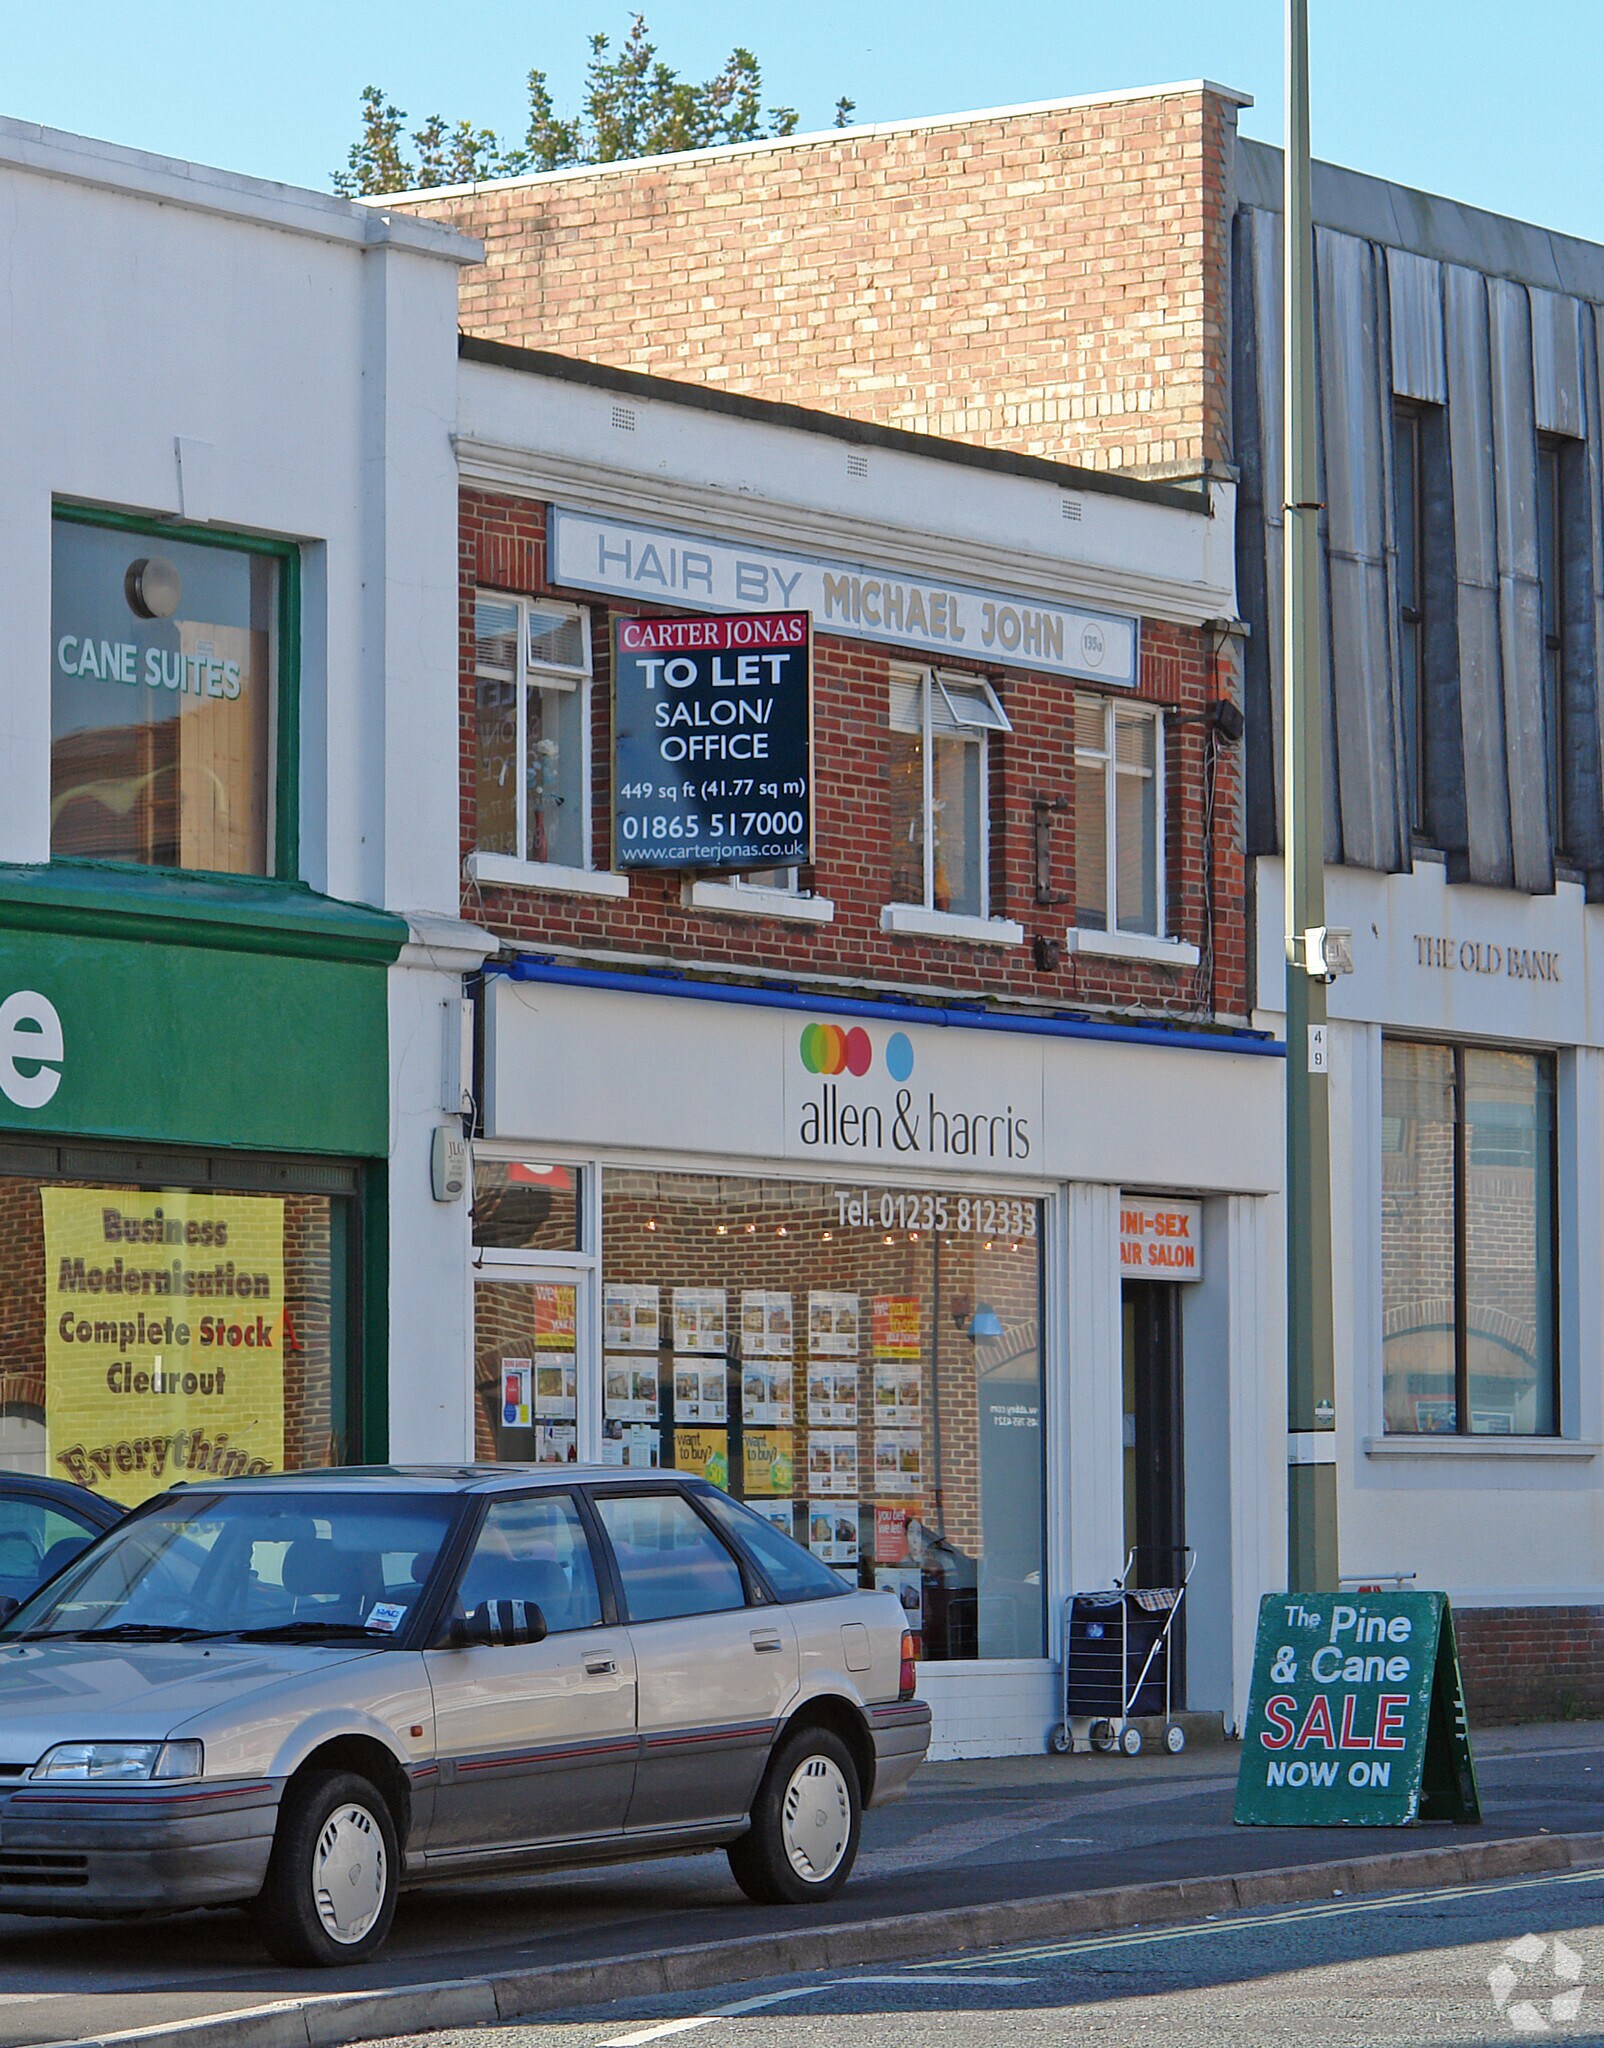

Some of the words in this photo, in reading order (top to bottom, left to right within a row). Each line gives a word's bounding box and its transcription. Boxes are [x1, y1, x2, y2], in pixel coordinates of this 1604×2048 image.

[598, 533, 713, 594] HAIR
[736, 560, 803, 608] BY
[823, 571, 966, 642] MICHAEL
[982, 604, 1064, 660] JOHN
[624, 622, 719, 648] CARTER
[725, 619, 802, 649] JONAS
[58, 634, 138, 684] CANE
[144, 647, 241, 700] SUITES
[636, 657, 698, 688] TO
[712, 654, 790, 686] LET
[655, 698, 773, 727] SALON/
[660, 733, 769, 762] OFFICE
[621, 782, 652, 799] 449
[658, 787, 677, 802] sq
[682, 781, 696, 798] ft
[701, 779, 754, 801] (41.77
[759, 783, 778, 799] sq
[783, 777, 806, 798] m)
[622, 815, 699, 839] 01865
[709, 811, 803, 837] 517000
[622, 840, 804, 862] www.carterjonas.co.uk
[1414, 934, 1457, 969] THE
[1460, 940, 1502, 974] OLD
[1507, 947, 1560, 982] BANK
[0, 990, 64, 1109] e
[1314, 1031, 1322, 1044] 4
[1314, 1052, 1322, 1065] 9
[801, 1083, 882, 1148] allen
[892, 1089, 920, 1151] &
[929, 1093, 1030, 1159] harris
[102, 1206, 229, 1247] Business
[834, 1191, 874, 1228] Tel.
[880, 1193, 948, 1231] 01235
[957, 1199, 1037, 1237] 812333
[1120, 1242, 1142, 1265] AIR
[1148, 1243, 1195, 1268] SALON
[57, 1257, 271, 1299] Modernisation
[59, 1311, 191, 1352] Complete
[200, 1316, 273, 1347] Stock
[107, 1361, 225, 1395] Clearout
[677, 1432, 701, 1446] want
[680, 1447, 690, 1459] to
[691, 1445, 712, 1463] buy?
[745, 1434, 767, 1447] want
[747, 1448, 756, 1461] to
[757, 1447, 777, 1463] buy?
[893, 1508, 906, 1520] bet
[1285, 1605, 1321, 1627] The
[1329, 1606, 1412, 1643] Pine
[1270, 1646, 1298, 1683] &
[1311, 1646, 1411, 1684] Cane
[1260, 1694, 1410, 1751] SALE
[1266, 1761, 1340, 1787] NOW
[1348, 1761, 1391, 1787] ON
